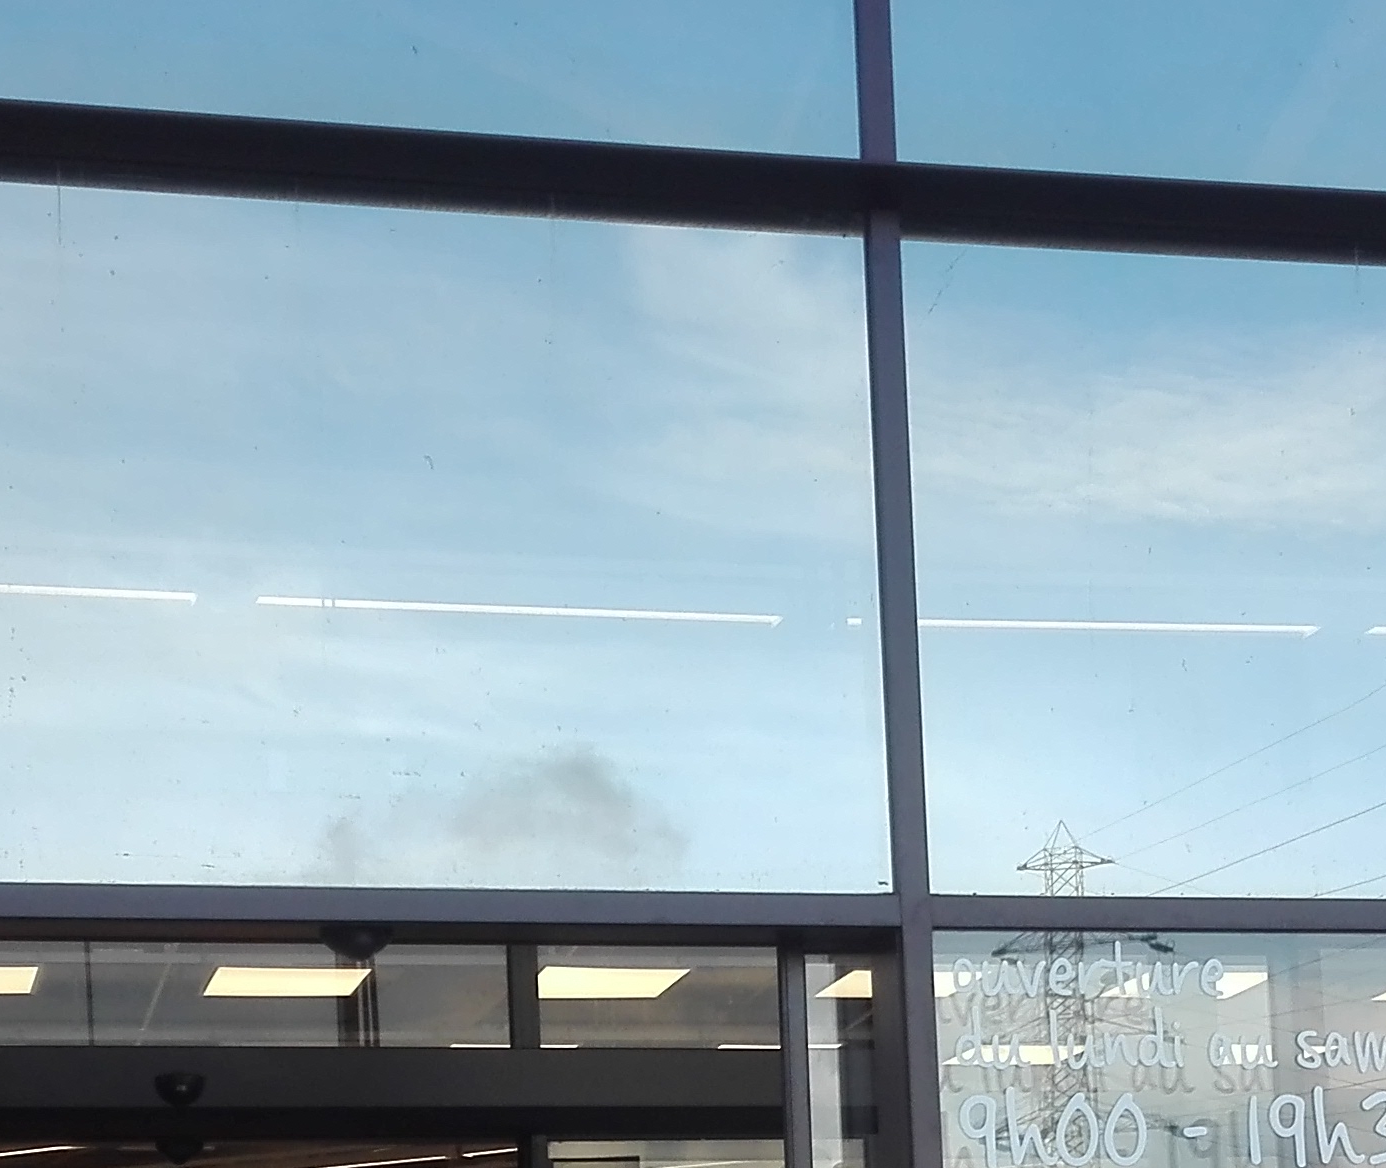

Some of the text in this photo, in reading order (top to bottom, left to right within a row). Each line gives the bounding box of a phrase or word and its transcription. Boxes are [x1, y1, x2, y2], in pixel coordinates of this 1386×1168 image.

[951, 941, 1225, 998] ouverture
[955, 1005, 1031, 1070] du
[1048, 1005, 1186, 1070] lundi
[1208, 1030, 1279, 1070] au
